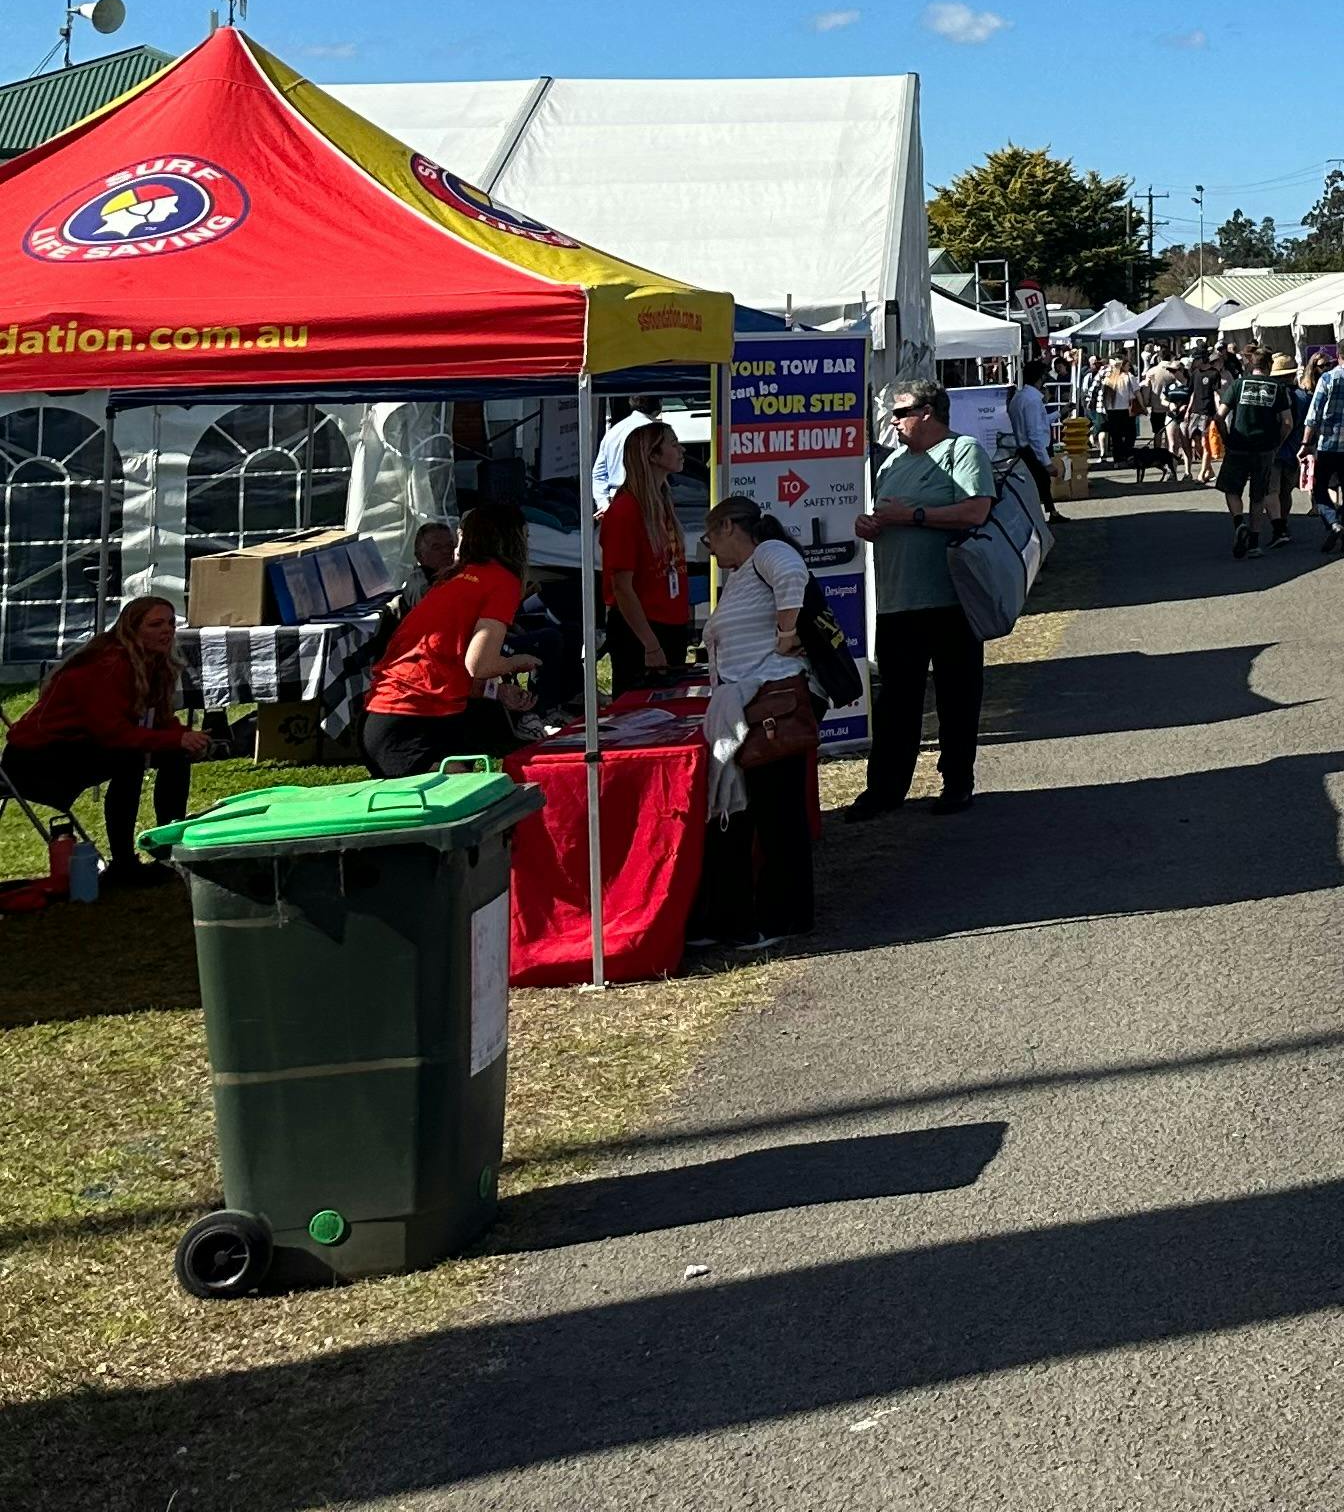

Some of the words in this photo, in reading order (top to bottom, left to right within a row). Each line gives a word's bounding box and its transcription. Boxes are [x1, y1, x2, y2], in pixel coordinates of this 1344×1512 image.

[106, 158, 223, 188] SURF
[32, 226, 79, 259] LIFE
[82, 215, 236, 259] SAVING
[730, 361, 776, 377] YOUR
[780, 359, 818, 375] TOW
[823, 358, 856, 373] BAR
[759, 381, 778, 395] be
[751, 395, 806, 415] YOUR
[810, 392, 857, 413] STEP
[730, 431, 765, 454] ASK
[769, 430, 794, 452] ME
[782, 481, 800, 494] TO
[830, 483, 855, 492] YOUR
[803, 497, 836, 508] SAFETY
[839, 495, 858, 505] STEP
